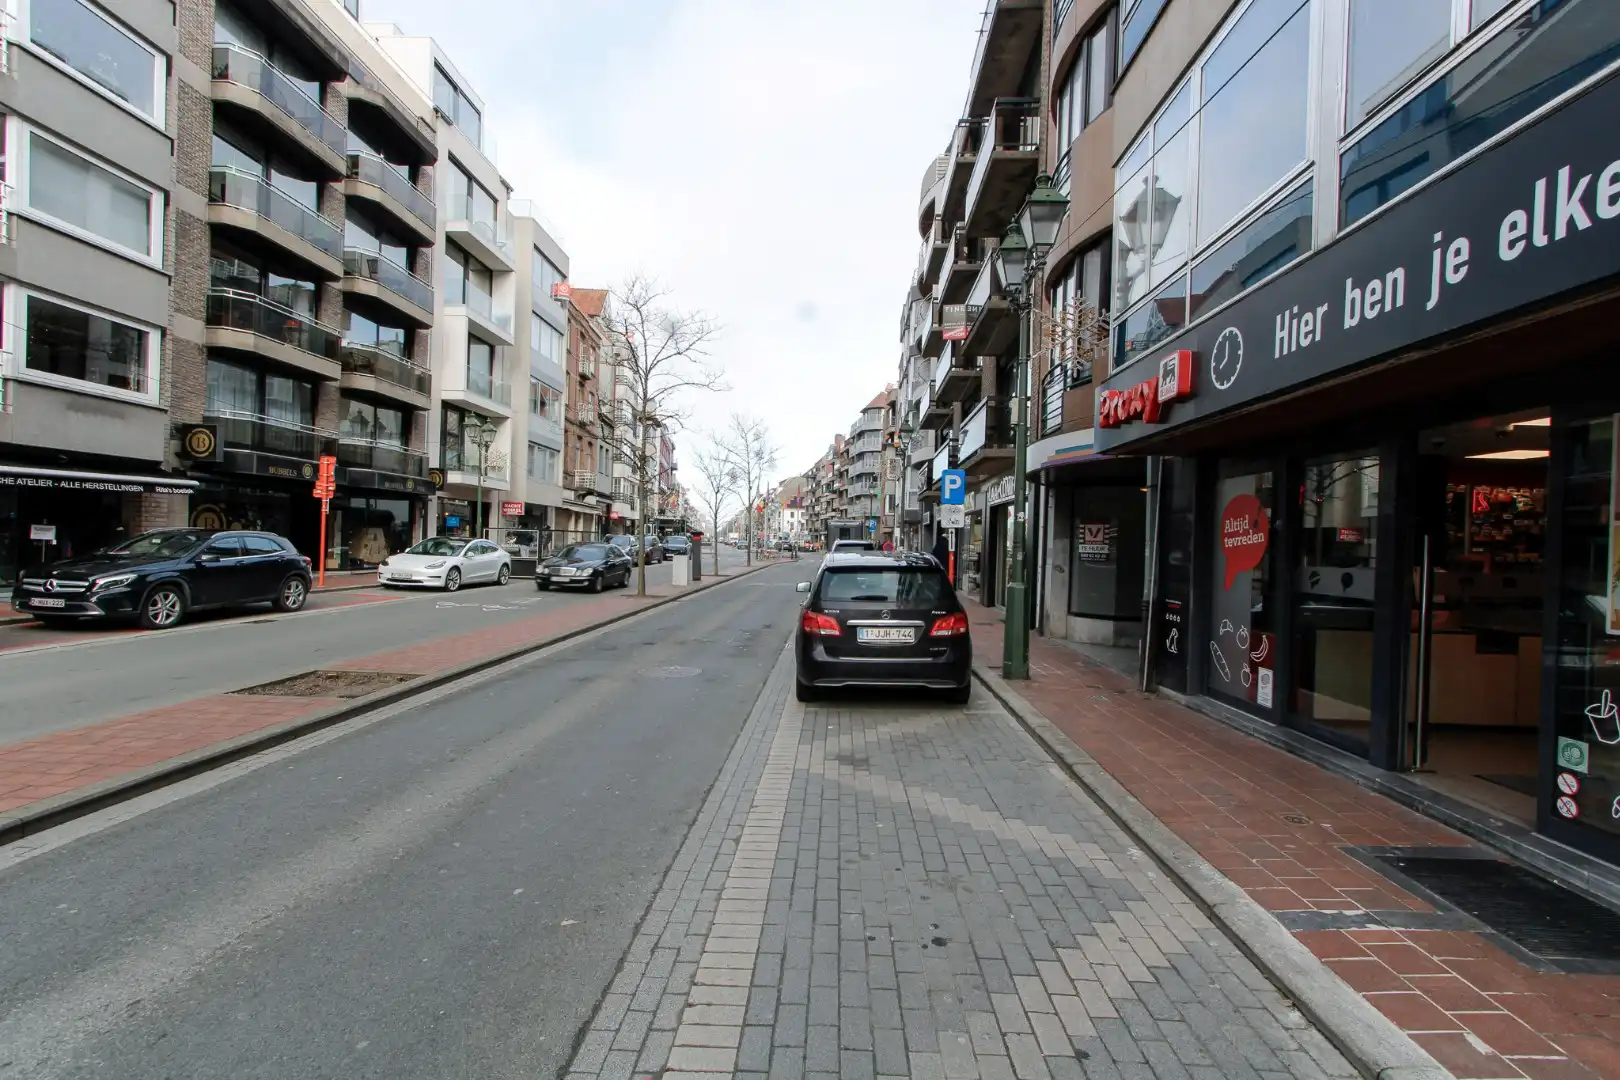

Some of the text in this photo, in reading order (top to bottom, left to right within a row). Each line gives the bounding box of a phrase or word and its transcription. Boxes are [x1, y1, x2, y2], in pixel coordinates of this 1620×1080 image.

[1274, 159, 1620, 359] Hier ben je elke
[196, 436, 206, 449] B
[0, 477, 15, 485] HE
[16, 477, 53, 487] ATELIER
[60, 480, 81, 489] ALLE
[82, 482, 144, 492] HERSTELLINGEN
[944, 475, 962, 499] P
[1224, 514, 1249, 533] Altijd
[1224, 530, 1264, 548] tevreden
